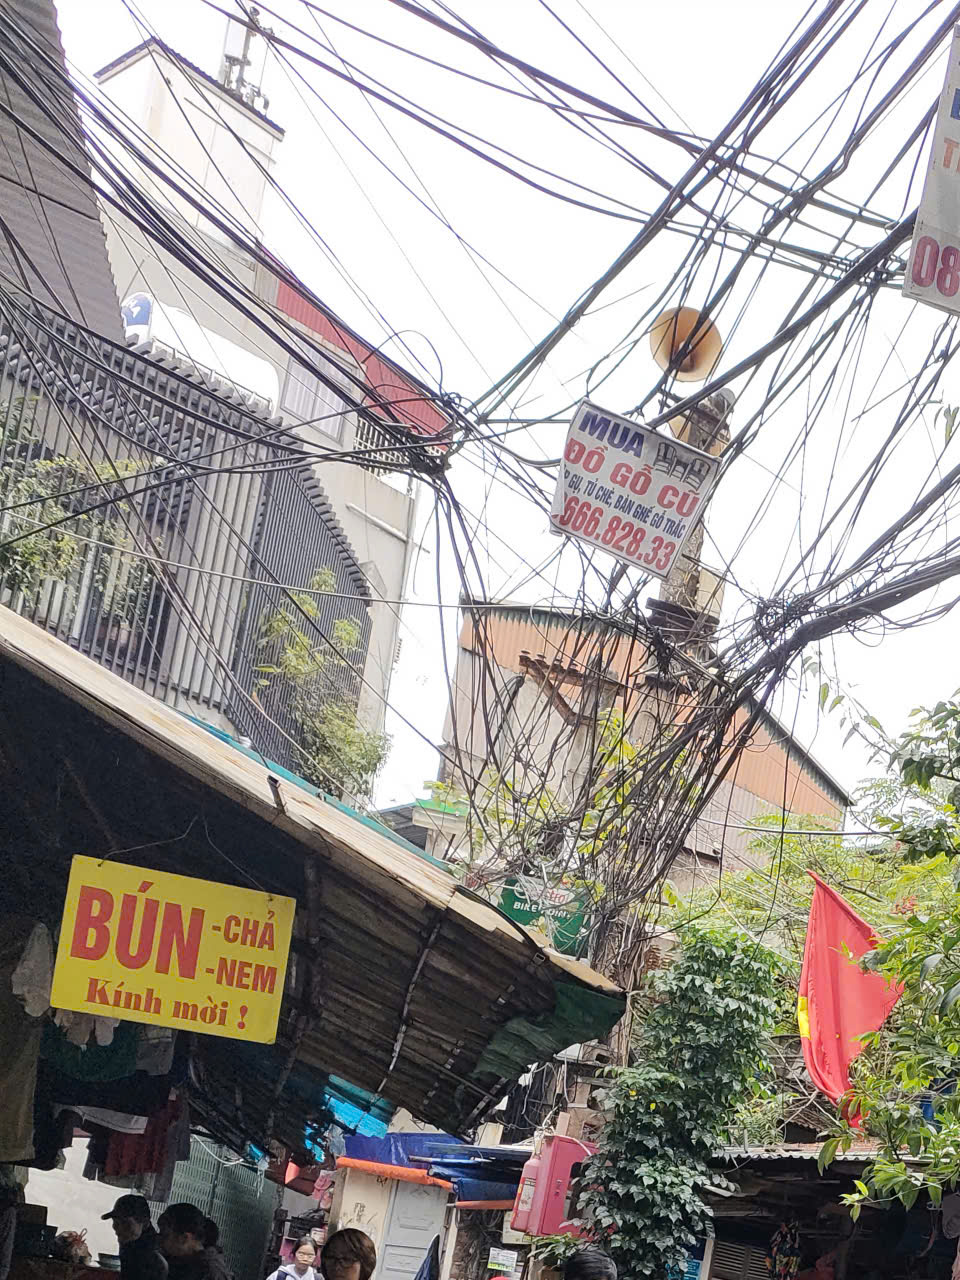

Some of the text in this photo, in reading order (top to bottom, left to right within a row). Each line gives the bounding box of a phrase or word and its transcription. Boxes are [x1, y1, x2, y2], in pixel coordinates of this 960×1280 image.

[578, 411, 645, 459] MUA
[564, 438, 608, 474] ĐỒ
[656, 484, 701, 518] CŨ
[70, 880, 206, 980] BÚN
[85, 976, 162, 1015] Kính
[172, 995, 229, 1026] mời
